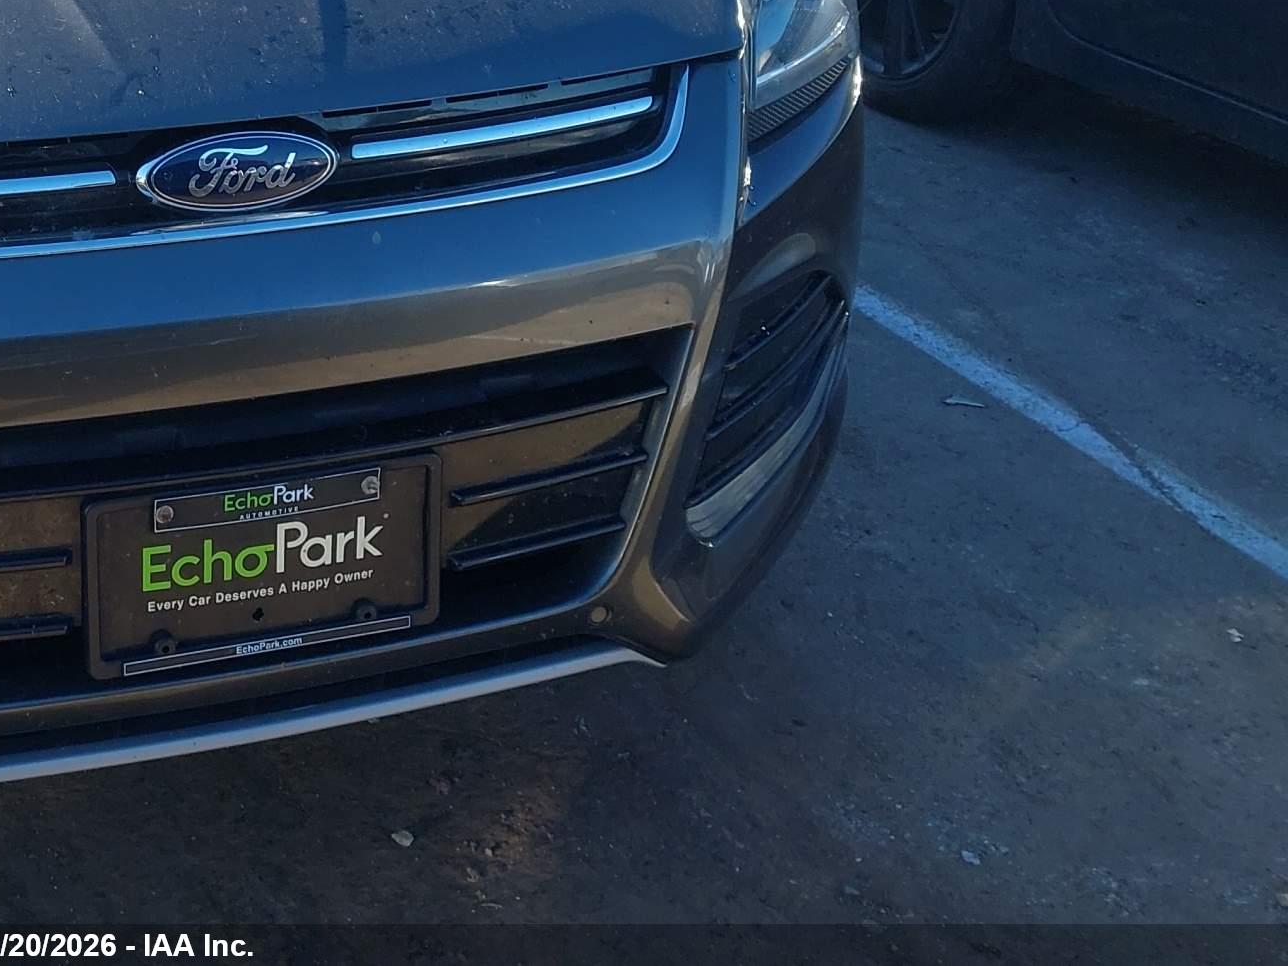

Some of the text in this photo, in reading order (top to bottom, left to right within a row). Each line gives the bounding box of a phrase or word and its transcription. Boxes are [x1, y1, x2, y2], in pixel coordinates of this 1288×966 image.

[188, 144, 297, 198] Ford
[224, 483, 314, 512] EchoPark
[239, 505, 299, 520] AUTOMOTIVE
[142, 516, 383, 592] EchoPark
[147, 568, 374, 613] Every Car Deserves A Happy Owner
[236, 637, 303, 655] EchoPark.com
